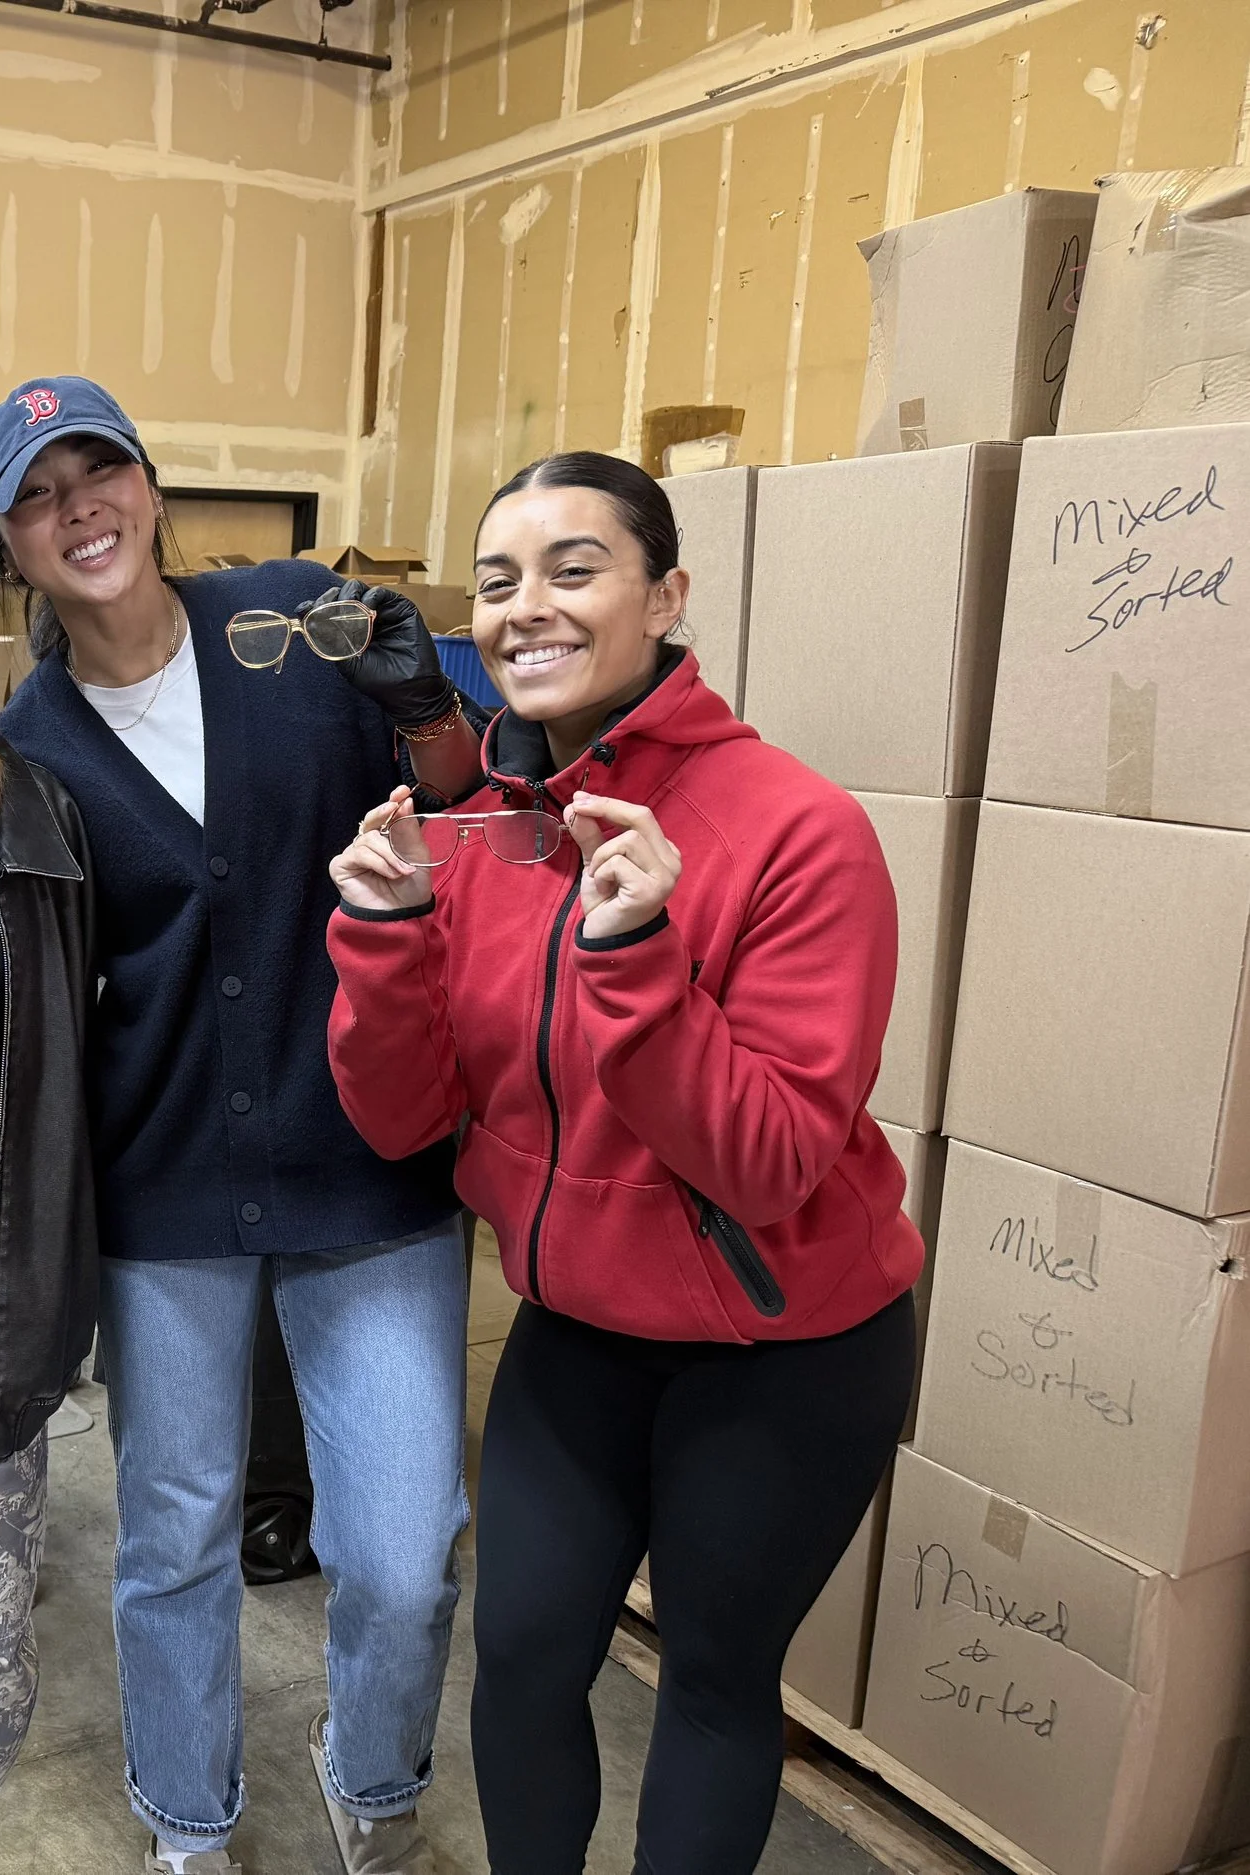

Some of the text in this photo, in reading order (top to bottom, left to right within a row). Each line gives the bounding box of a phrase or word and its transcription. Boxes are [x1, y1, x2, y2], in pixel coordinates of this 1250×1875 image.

[15, 388, 61, 427] B
[1053, 464, 1226, 565] Mixed
[1064, 556, 1234, 653] Sorted
[989, 1215, 1099, 1292] Mixed
[970, 1329, 1136, 1427] Sorted
[914, 1543, 1070, 1650] Mixed
[919, 1660, 1058, 1738] Sorted
